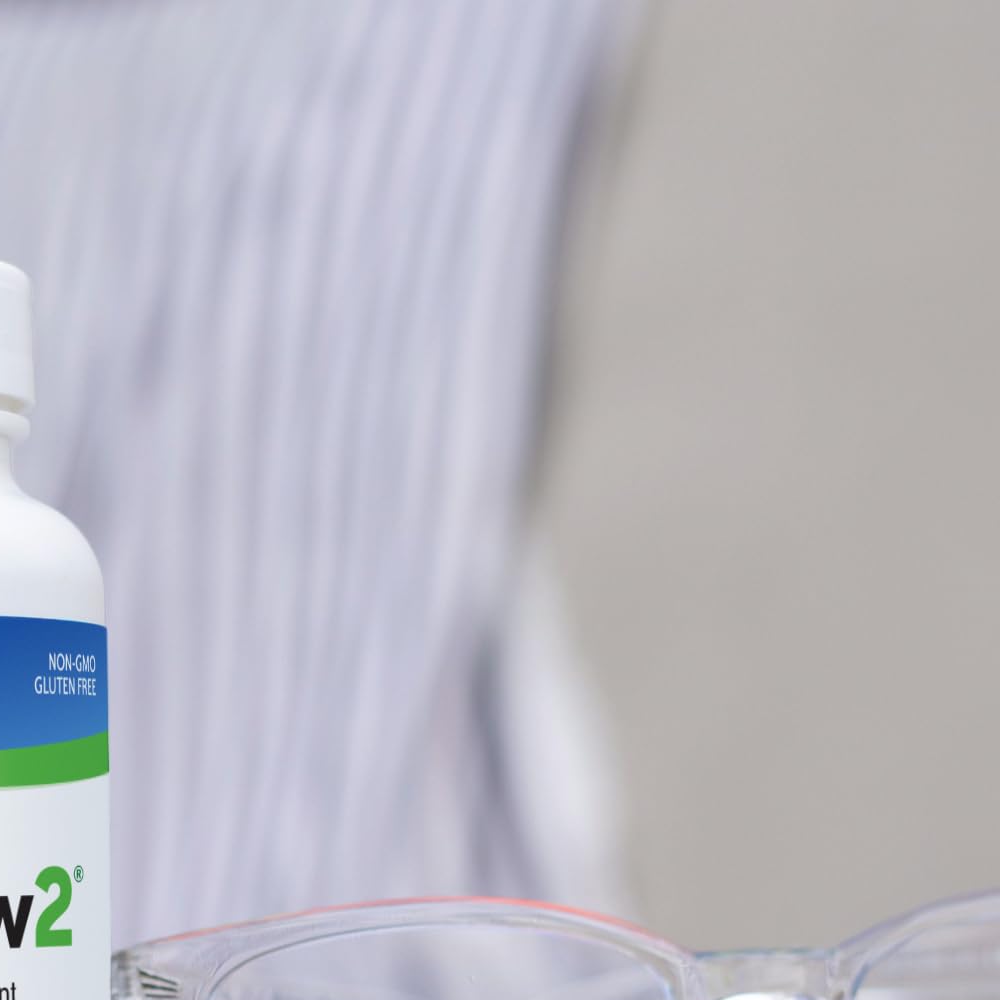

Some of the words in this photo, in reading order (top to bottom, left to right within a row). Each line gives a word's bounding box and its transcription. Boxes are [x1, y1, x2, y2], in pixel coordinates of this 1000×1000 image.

[48, 653, 96, 673] NON-GMO
[34, 675, 76, 695] GLUTEN
[77, 677, 97, 696] FREE
